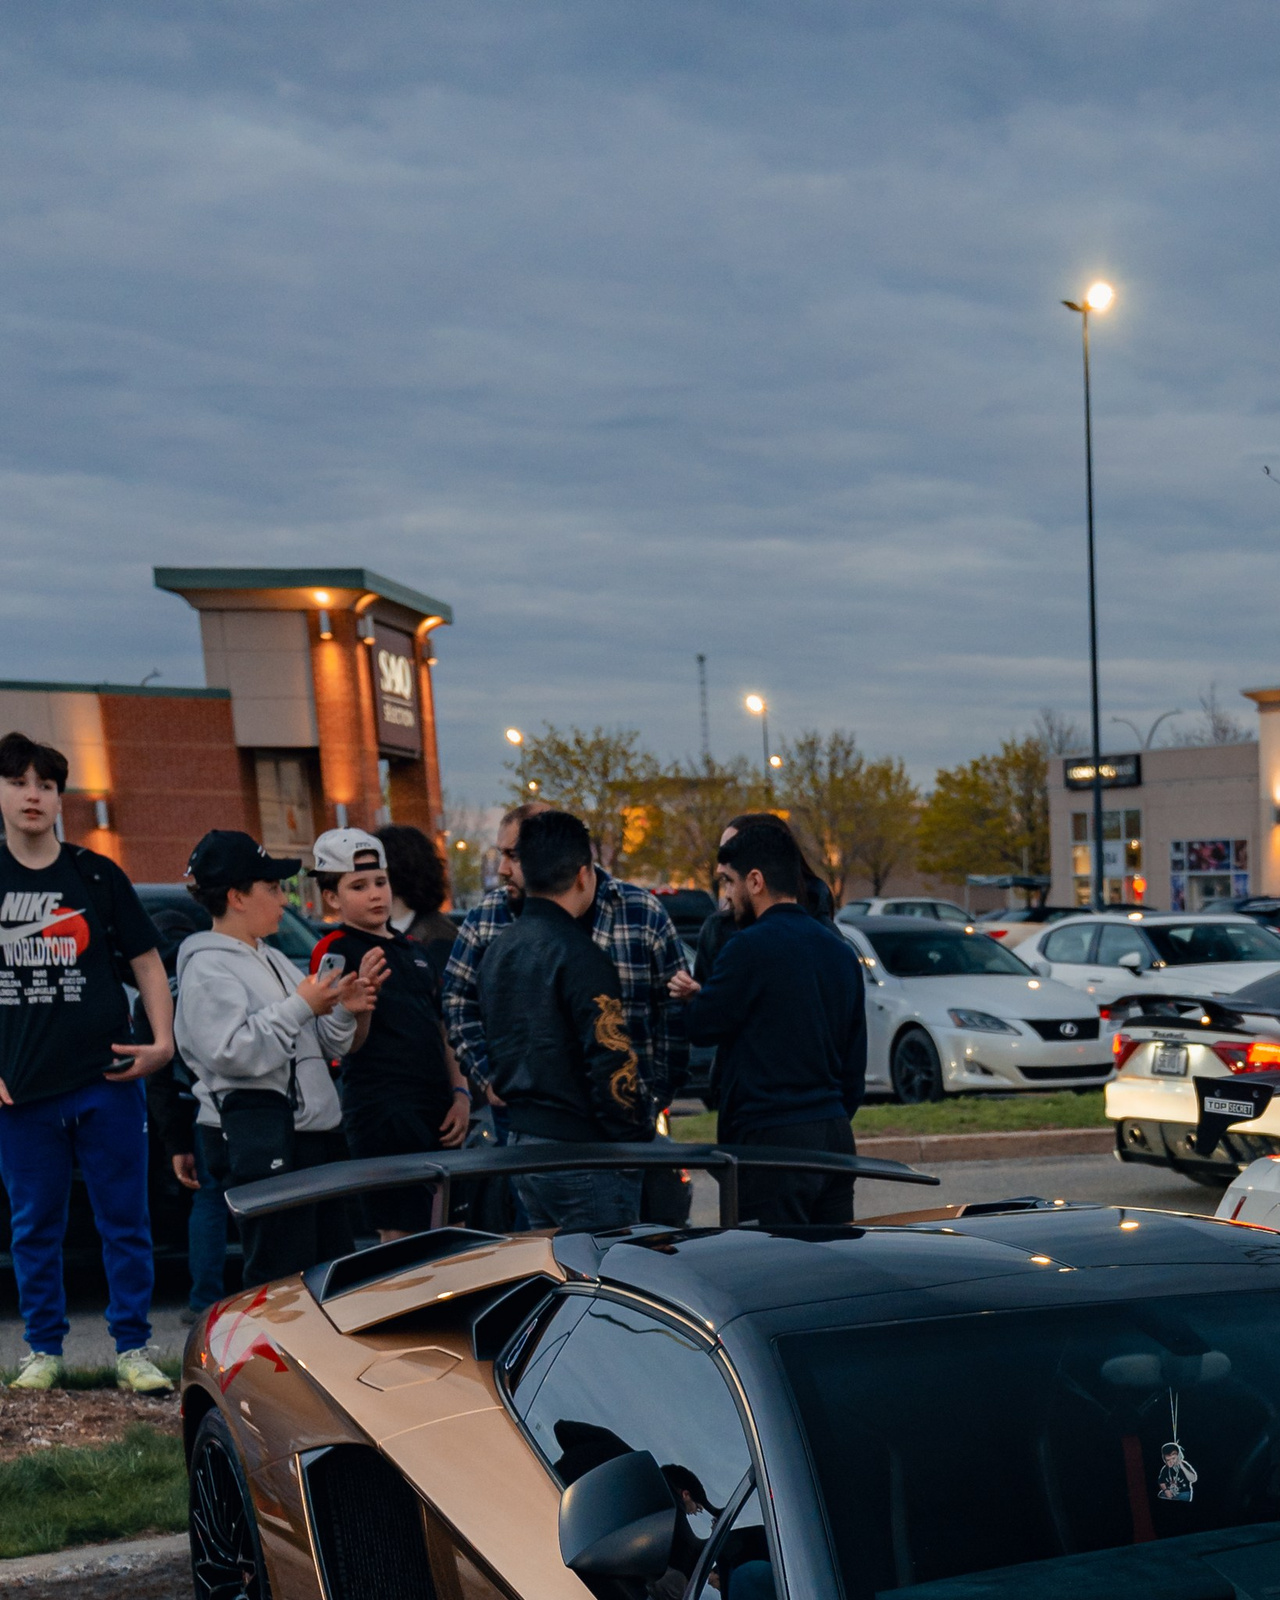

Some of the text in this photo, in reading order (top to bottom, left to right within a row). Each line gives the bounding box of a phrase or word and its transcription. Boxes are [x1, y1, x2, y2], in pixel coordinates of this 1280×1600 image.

[0, 892, 63, 921] NIKE
[1208, 1101, 1252, 1115] TOP SECRET
